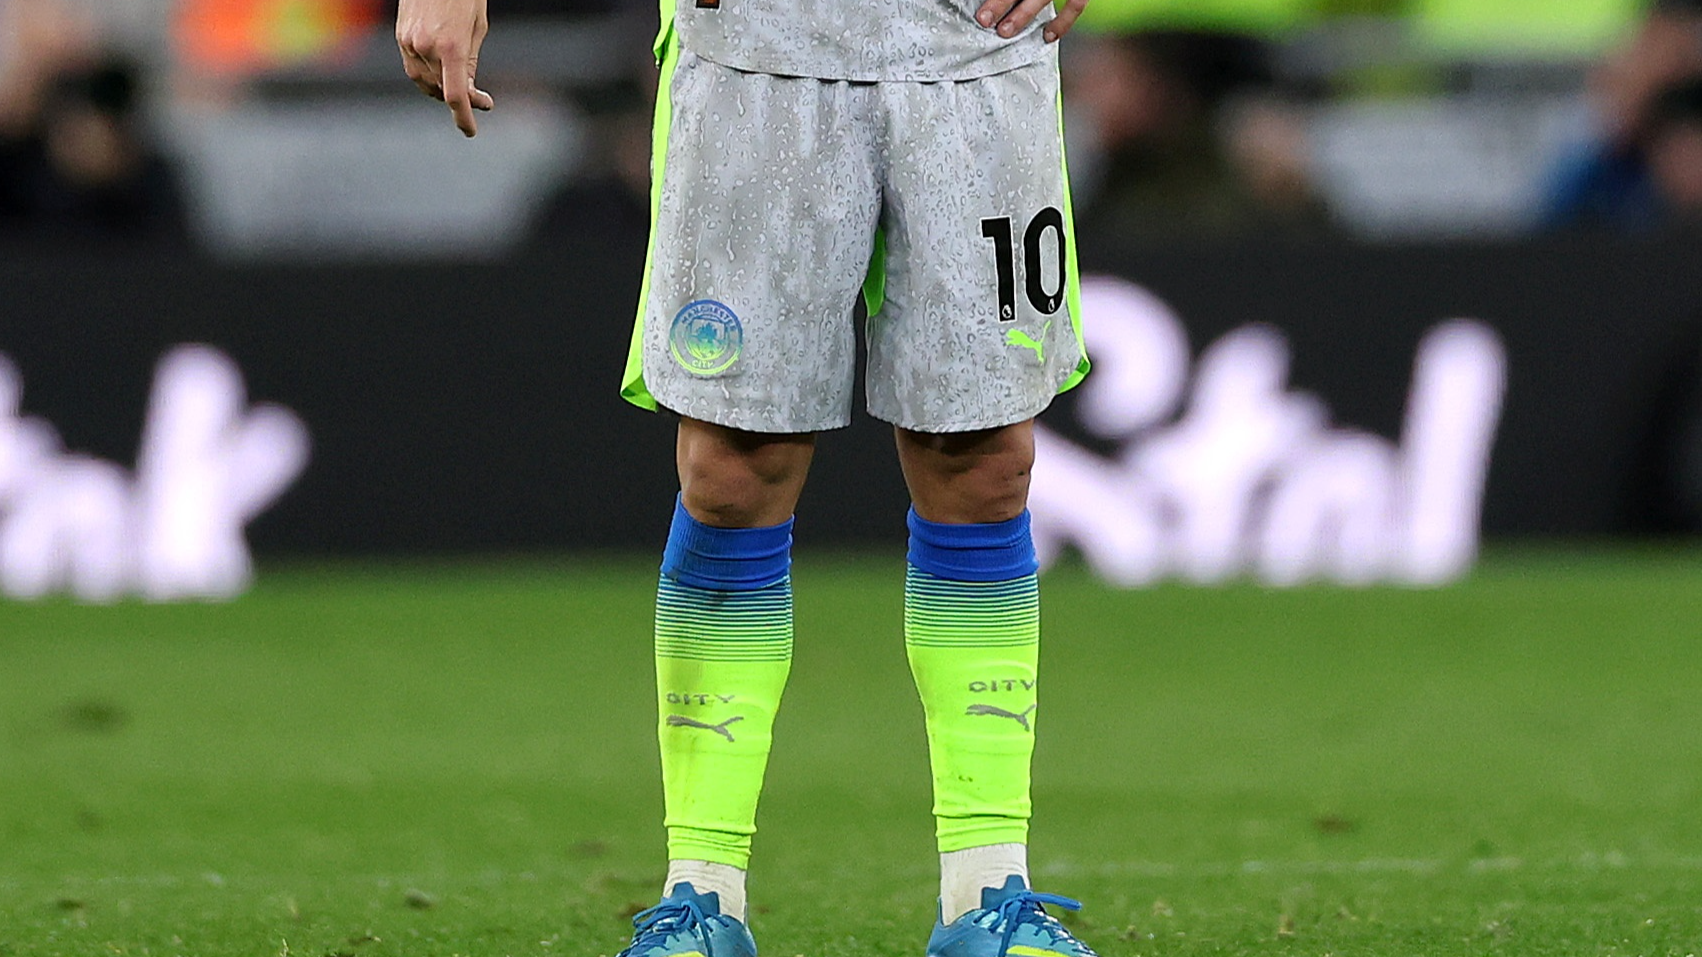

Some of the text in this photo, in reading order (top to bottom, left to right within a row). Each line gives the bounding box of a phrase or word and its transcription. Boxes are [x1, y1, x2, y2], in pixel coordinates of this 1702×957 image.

[980, 205, 1066, 323] 10
[691, 359, 714, 369] CITY
[968, 678, 1036, 693] CITY
[666, 692, 736, 706] CITY
